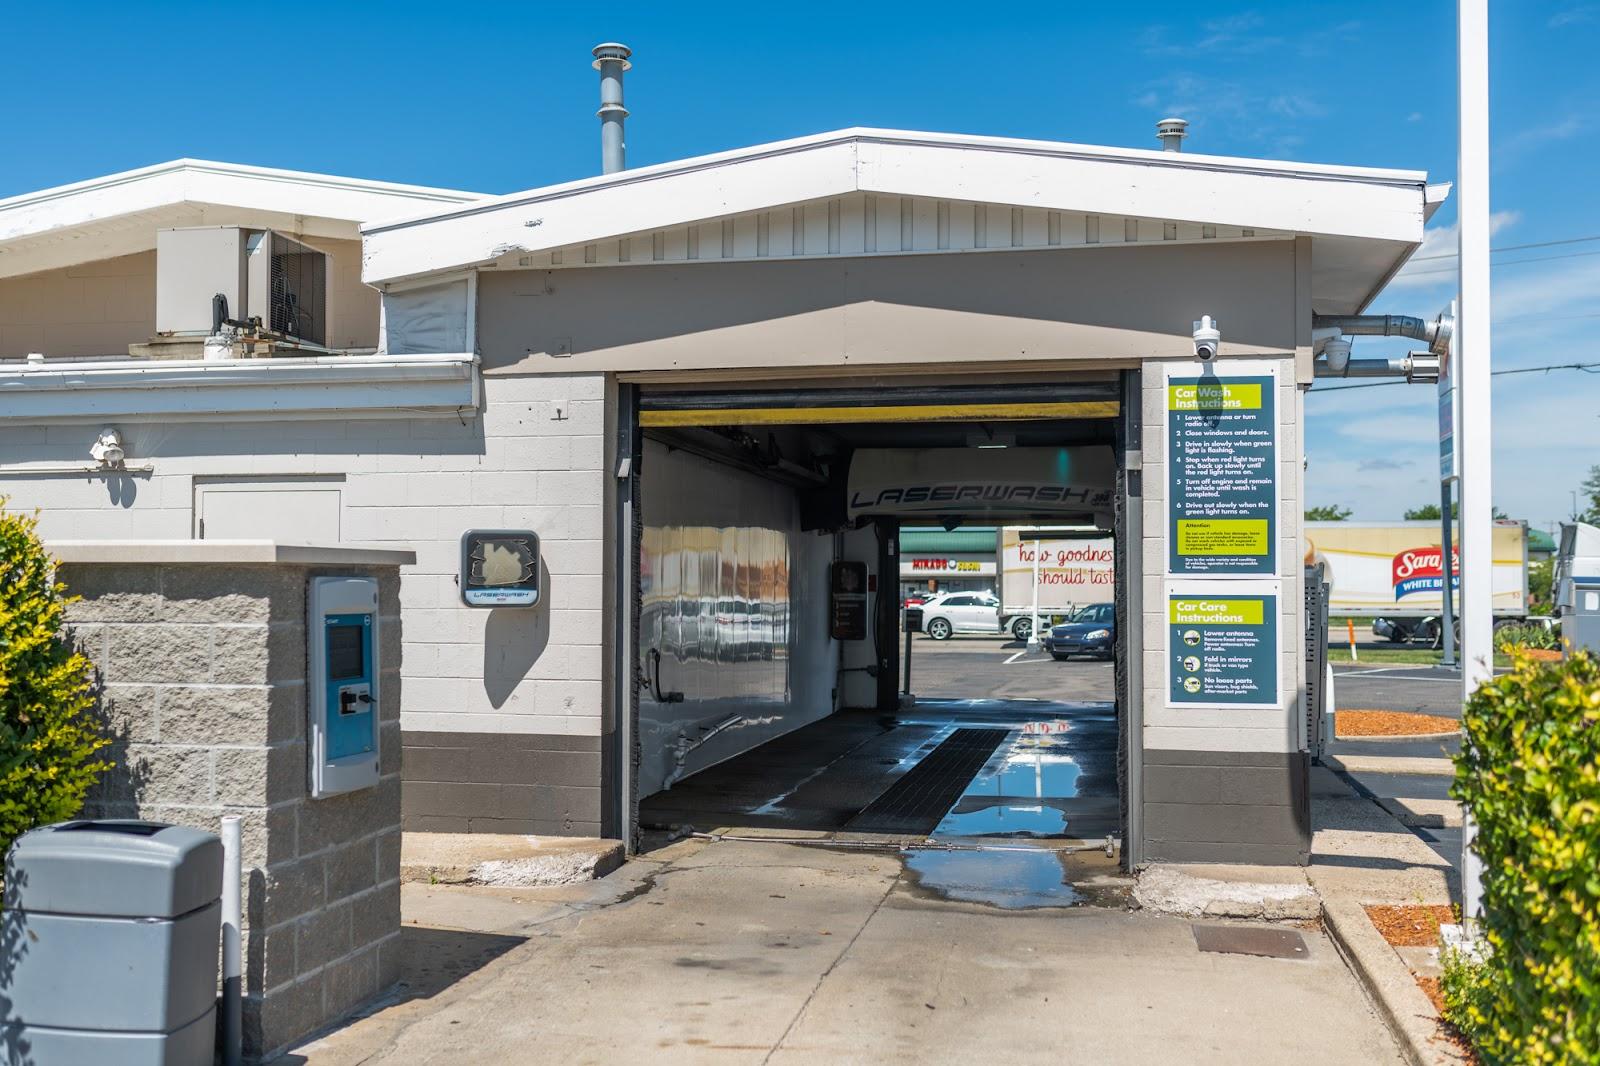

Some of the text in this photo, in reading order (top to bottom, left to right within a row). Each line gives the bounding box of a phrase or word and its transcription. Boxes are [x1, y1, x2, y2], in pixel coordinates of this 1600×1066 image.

[1175, 386, 1231, 398] Car Wash
[1175, 398, 1241, 409] Instructions
[851, 485, 1091, 509] LASERWASH
[1017, 544, 1052, 562] how
[1396, 553, 1441, 577] Sara
[1038, 568, 1085, 584] should
[1403, 579, 1432, 591] WHITE
[1177, 602, 1228, 611] Car Care
[1177, 612, 1243, 622] Instructions
